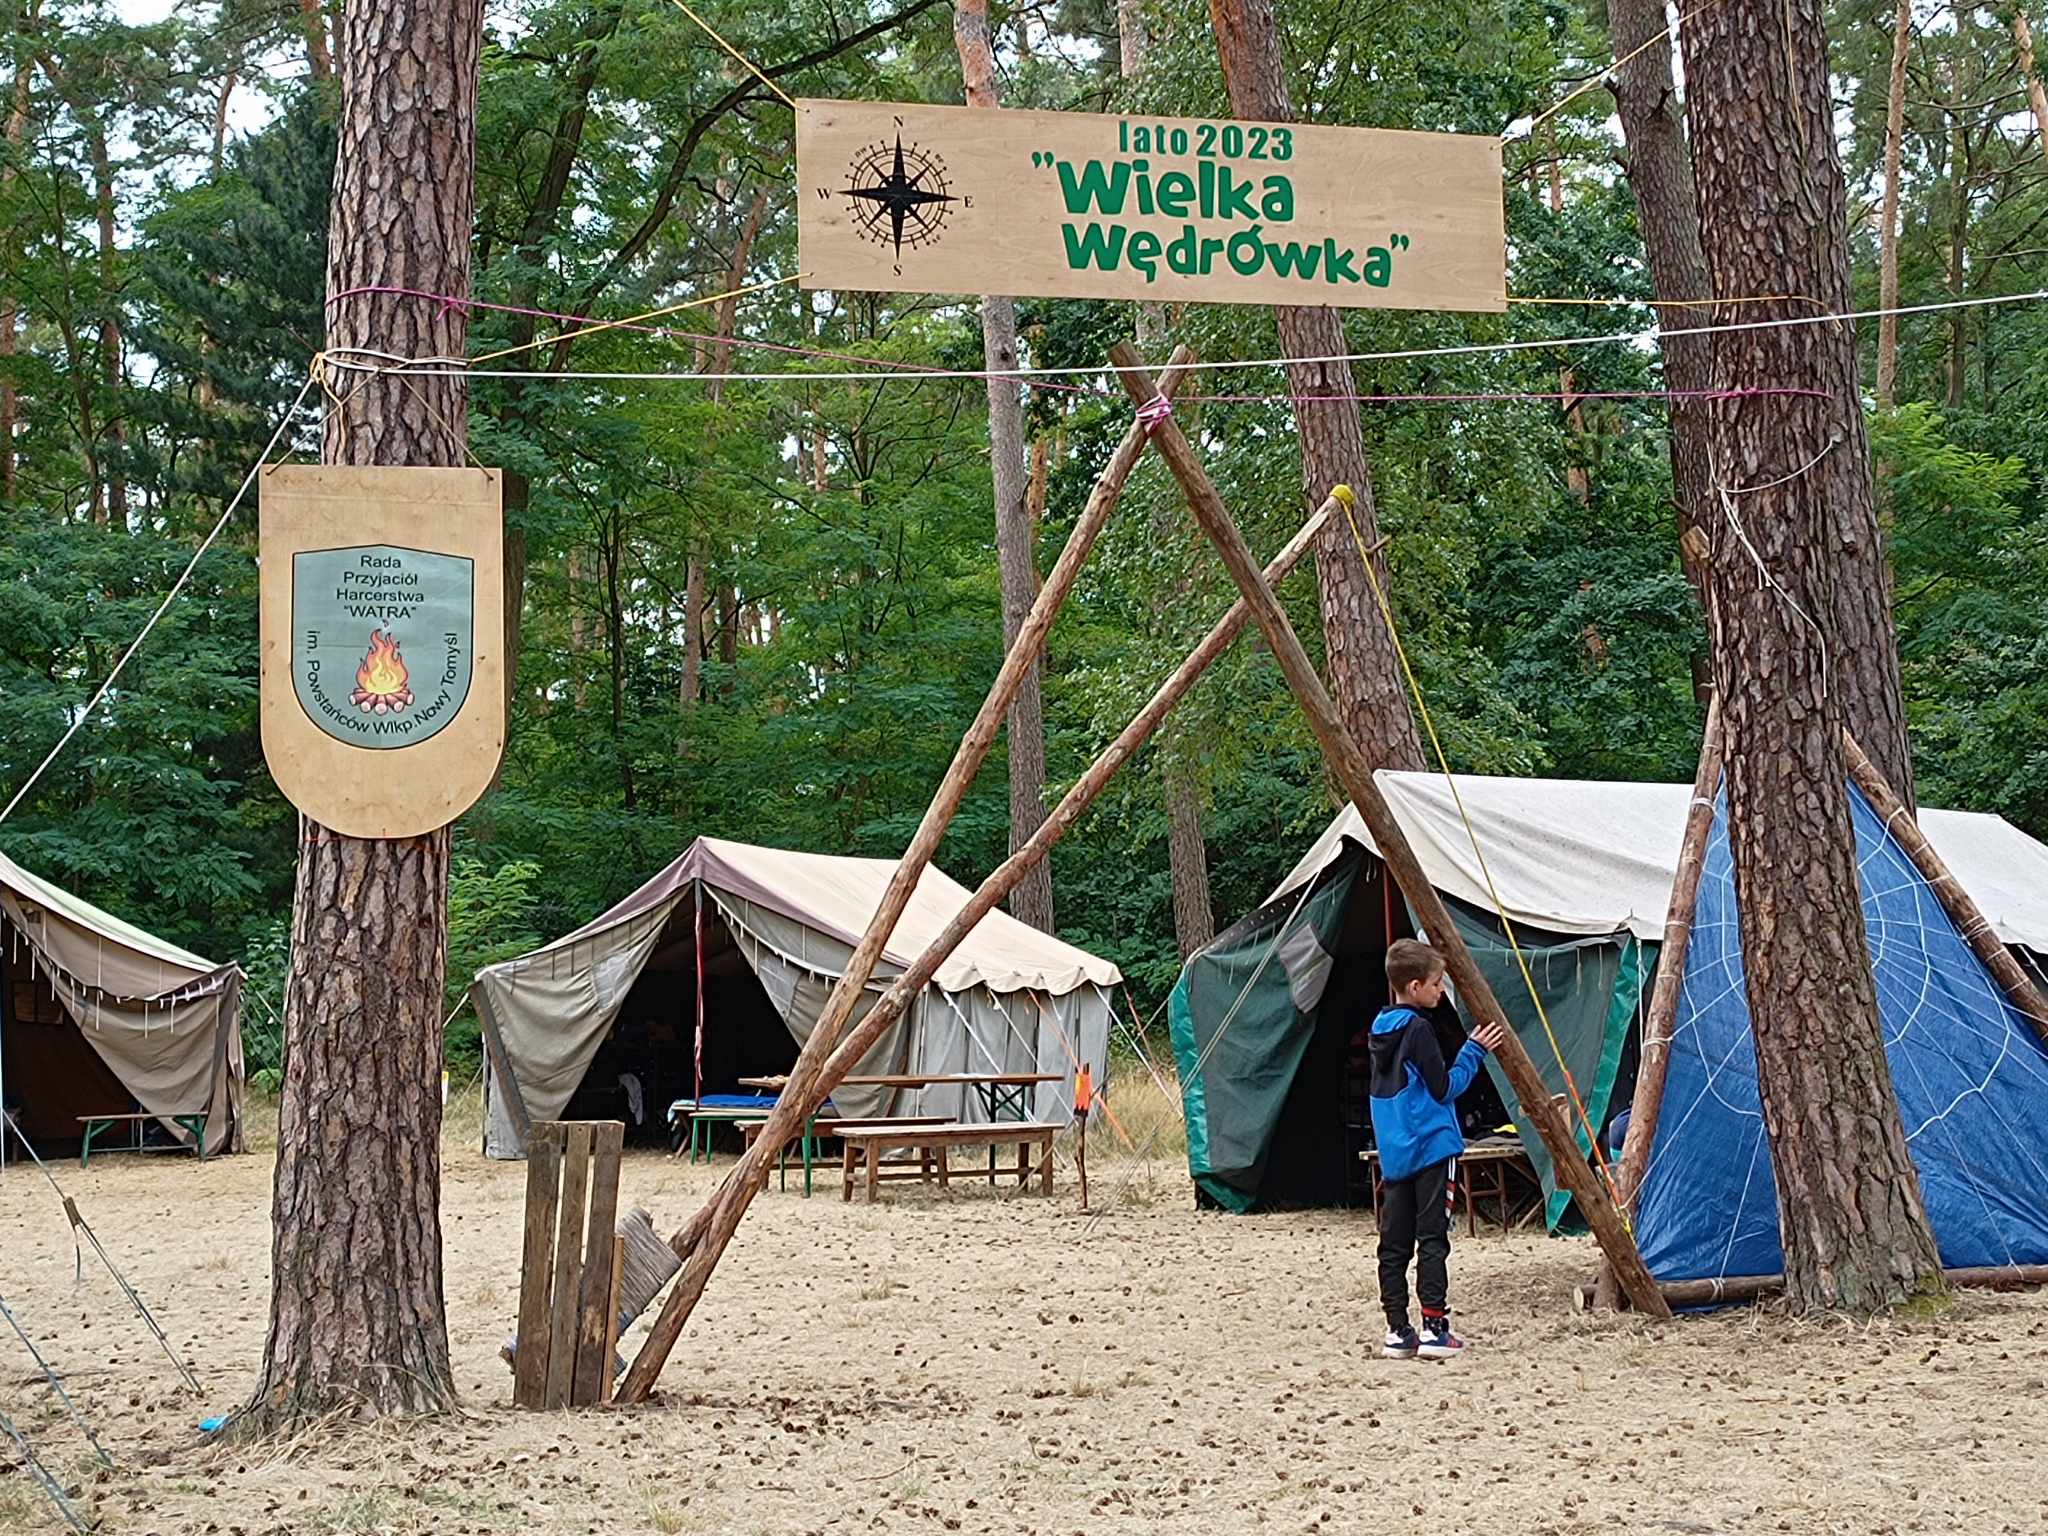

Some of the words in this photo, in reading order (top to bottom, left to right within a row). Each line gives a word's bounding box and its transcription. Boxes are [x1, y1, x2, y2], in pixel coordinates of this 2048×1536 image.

[894, 116, 904, 128] N
[1118, 120, 1189, 155] lato
[1196, 124, 1293, 161] 2023
[816, 188, 832, 200] W
[964, 196, 974, 208] E
[893, 264, 902, 276] S
[360, 555, 402, 568] Rada
[343, 571, 418, 587] Przyjaciół
[336, 588, 425, 602] Harcerstwa
[306, 630, 320, 654] im.
[440, 632, 461, 686] Tomyśl
[307, 660, 370, 733] Powstańców
